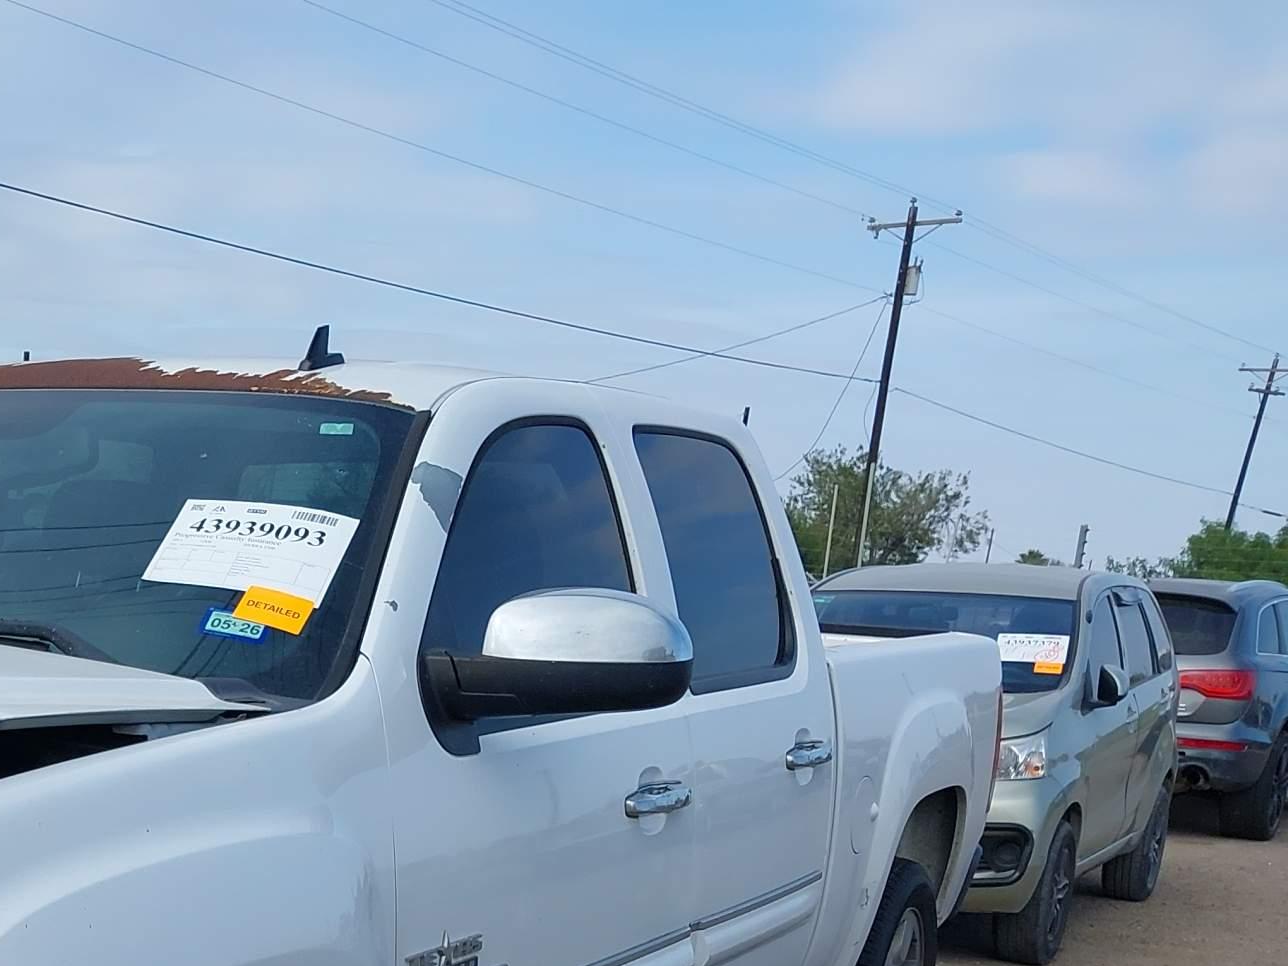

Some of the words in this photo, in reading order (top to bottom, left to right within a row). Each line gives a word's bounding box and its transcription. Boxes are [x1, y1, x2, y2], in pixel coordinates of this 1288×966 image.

[189, 518, 327, 547] 43939093
[246, 599, 301, 620] DETAILED
[210, 617, 233, 630] 05
[239, 623, 262, 636] 26
